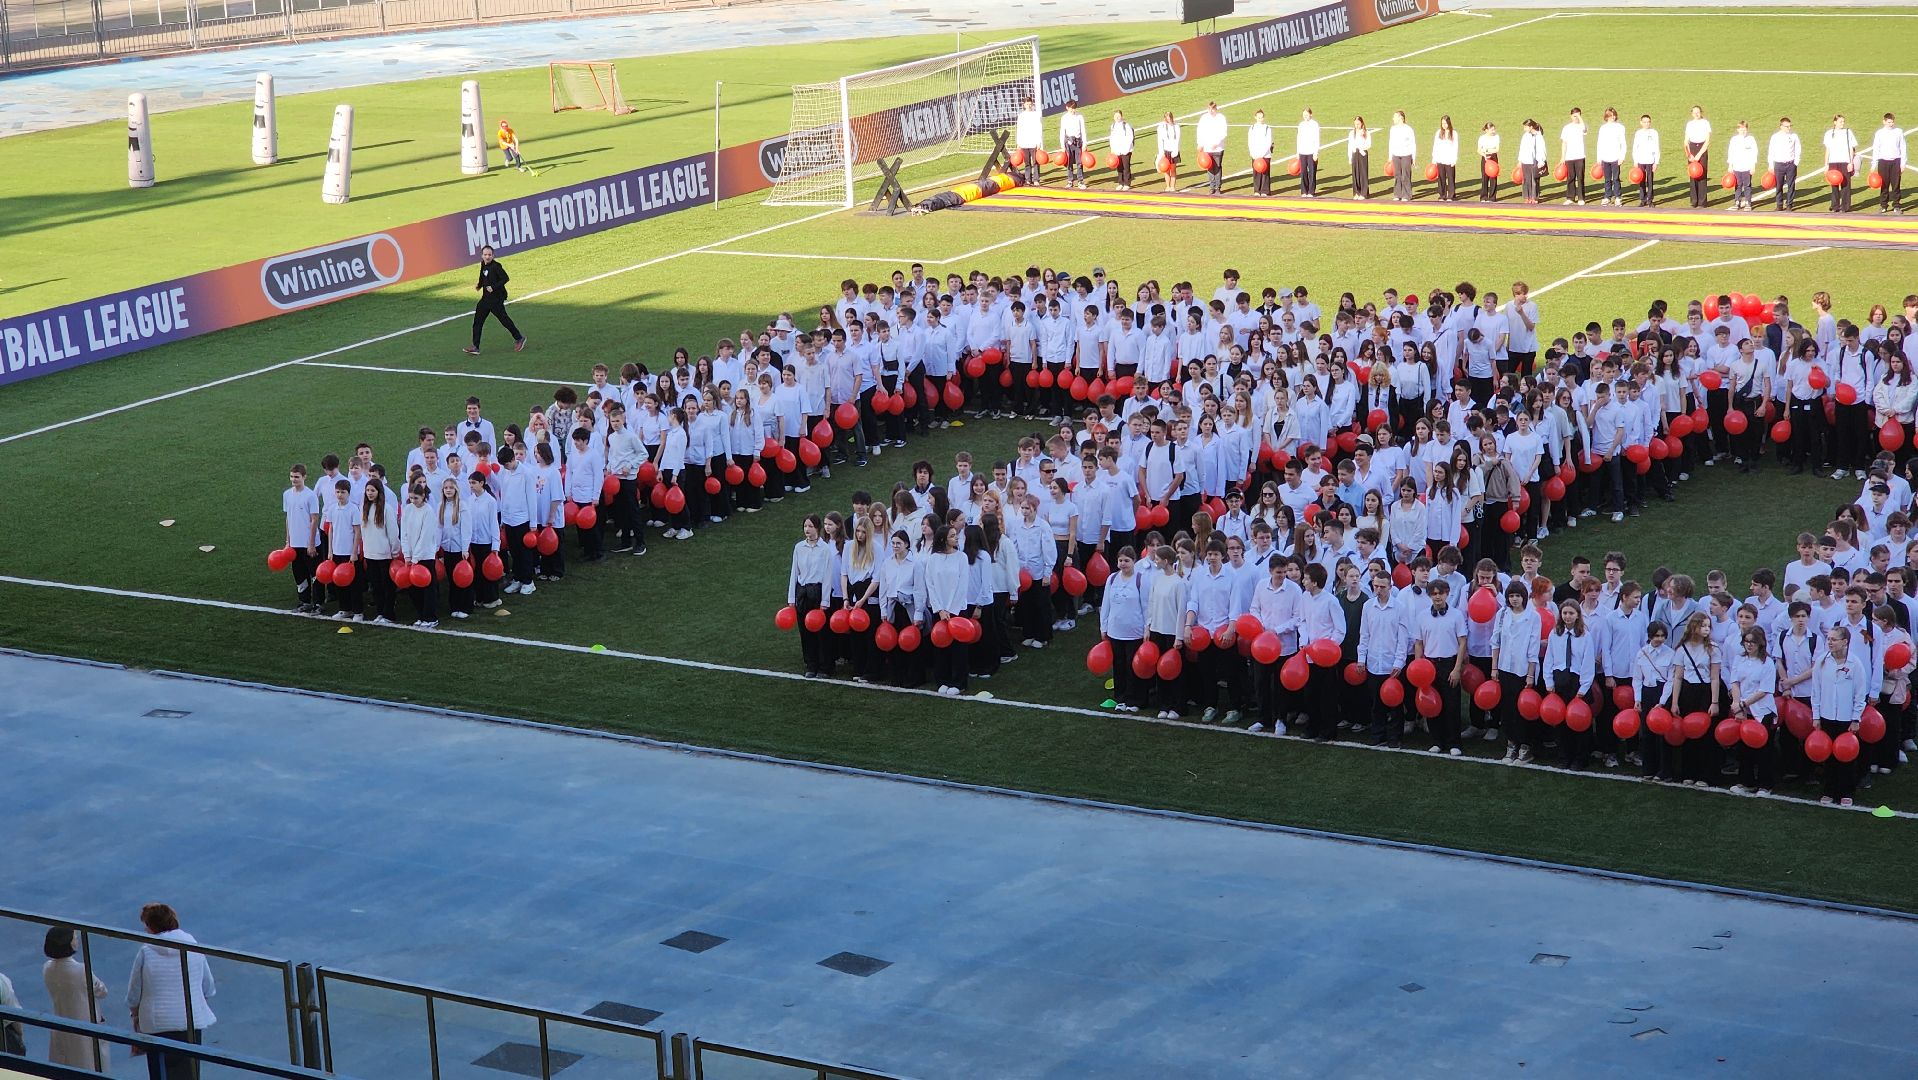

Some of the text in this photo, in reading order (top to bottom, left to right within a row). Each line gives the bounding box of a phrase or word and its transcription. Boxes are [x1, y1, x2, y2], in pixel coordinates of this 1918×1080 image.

[1220, 6, 1350, 65] MEDIA FOOTBALL LEAGUE
[1119, 59, 1169, 84] Winline
[900, 104, 952, 144] MEDIA
[466, 161, 710, 256] MEDIA FOOTBALL LEAGUE
[272, 257, 367, 296] Winline
[83, 287, 190, 352] LEAGUE
